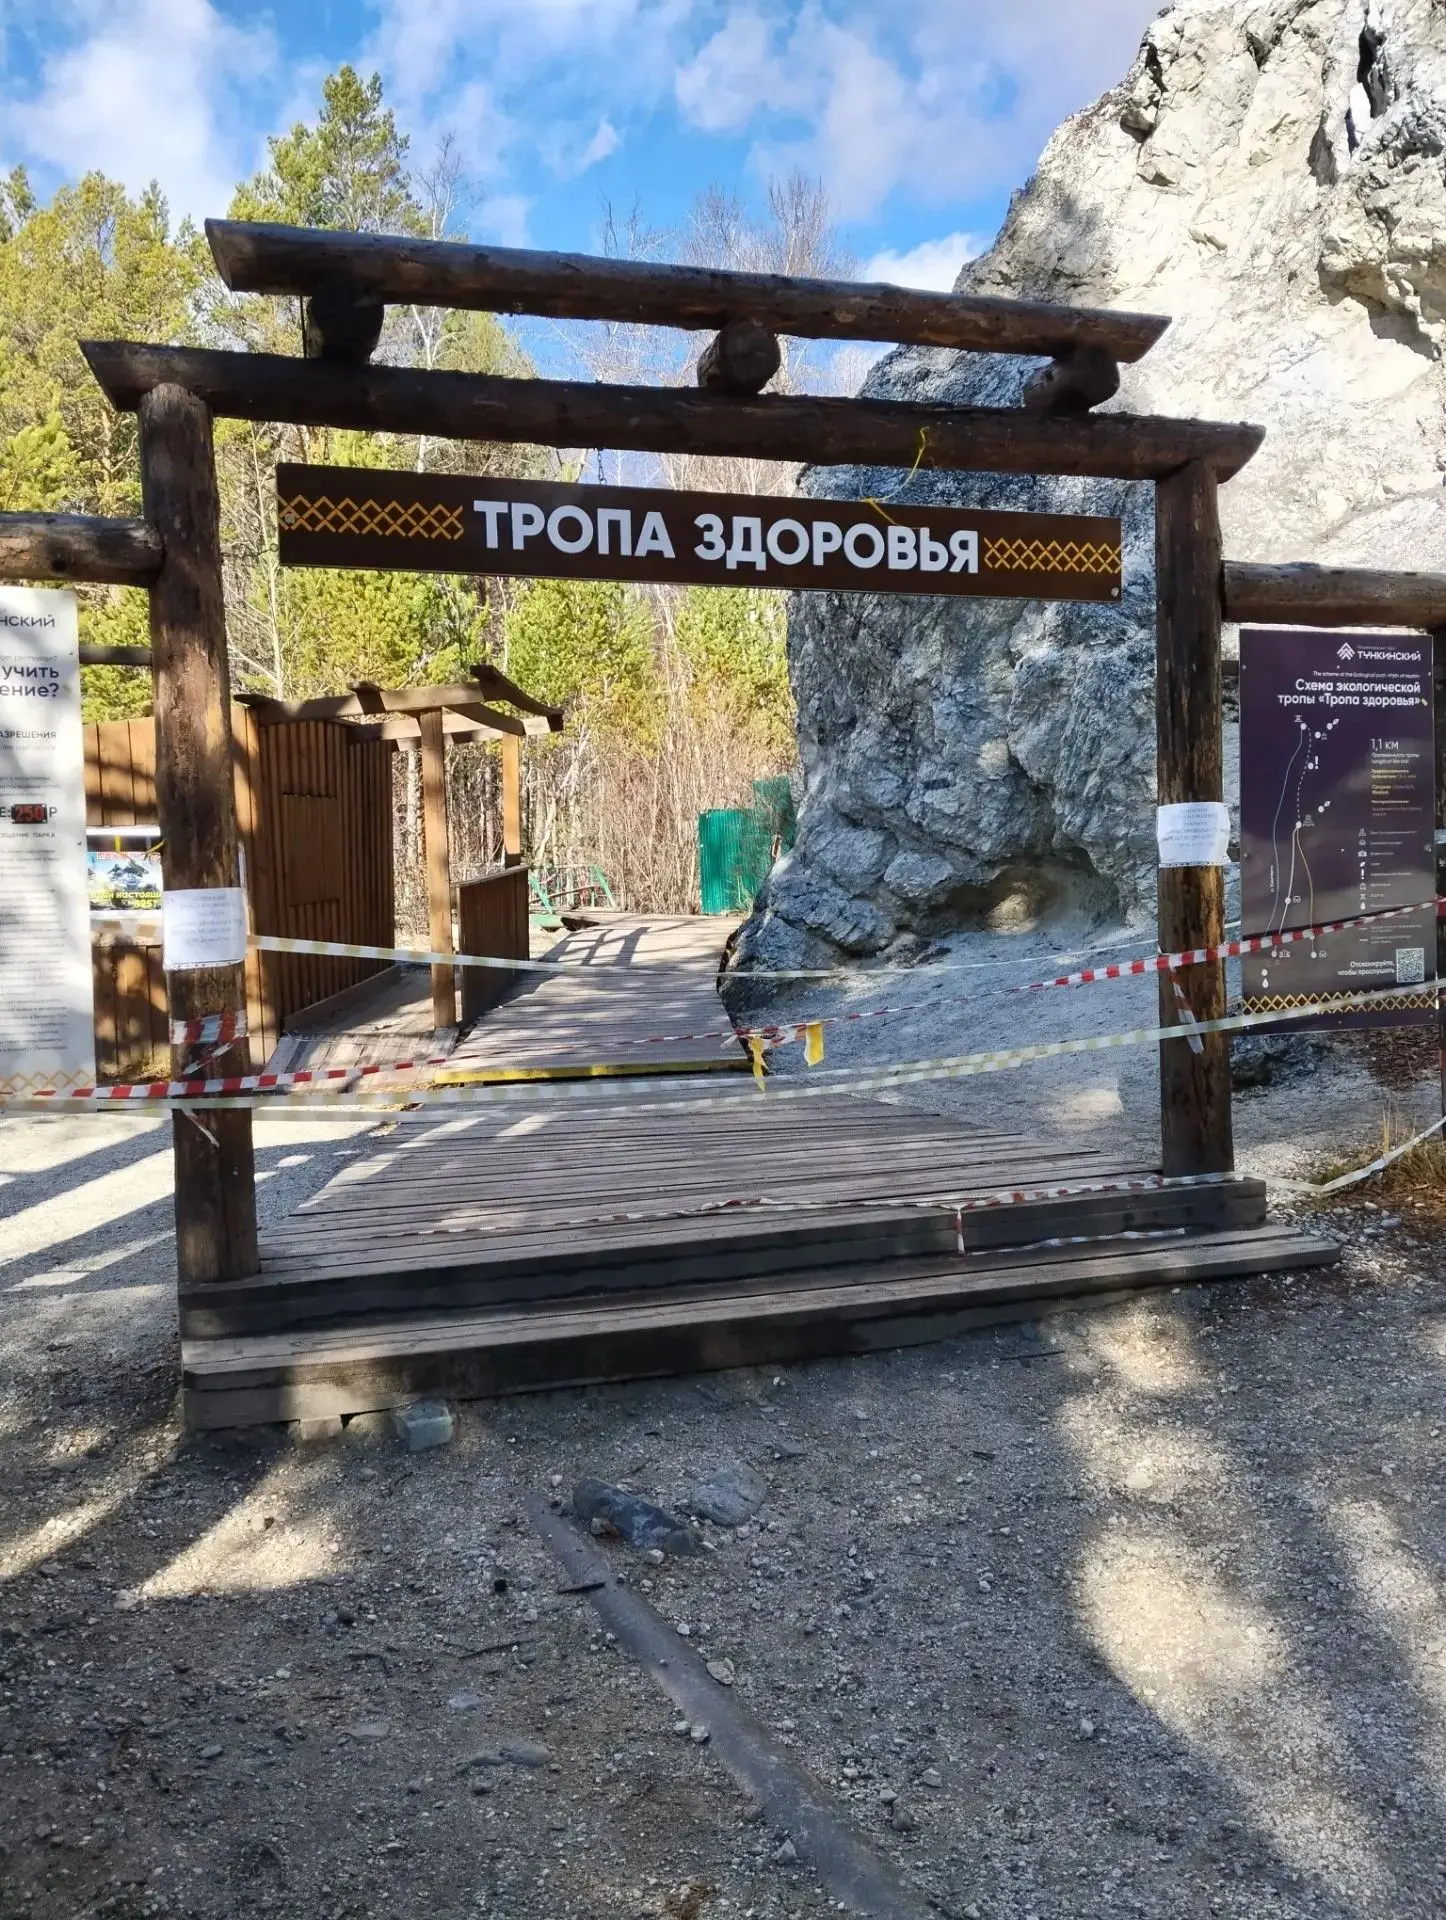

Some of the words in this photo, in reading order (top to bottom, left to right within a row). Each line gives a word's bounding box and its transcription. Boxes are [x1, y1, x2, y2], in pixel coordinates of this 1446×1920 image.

[474, 501, 676, 557] ТРОПА
[695, 514, 979, 573] ЗДОРОВЬЯ
[2, 666, 60, 680] учить
[1295, 678, 1333, 691] Схема
[1336, 681, 1421, 693] экологической
[1278, 694, 1315, 707] тропы
[1318, 693, 1360, 707] «Тропа
[1362, 695, 1420, 708] здоровья»
